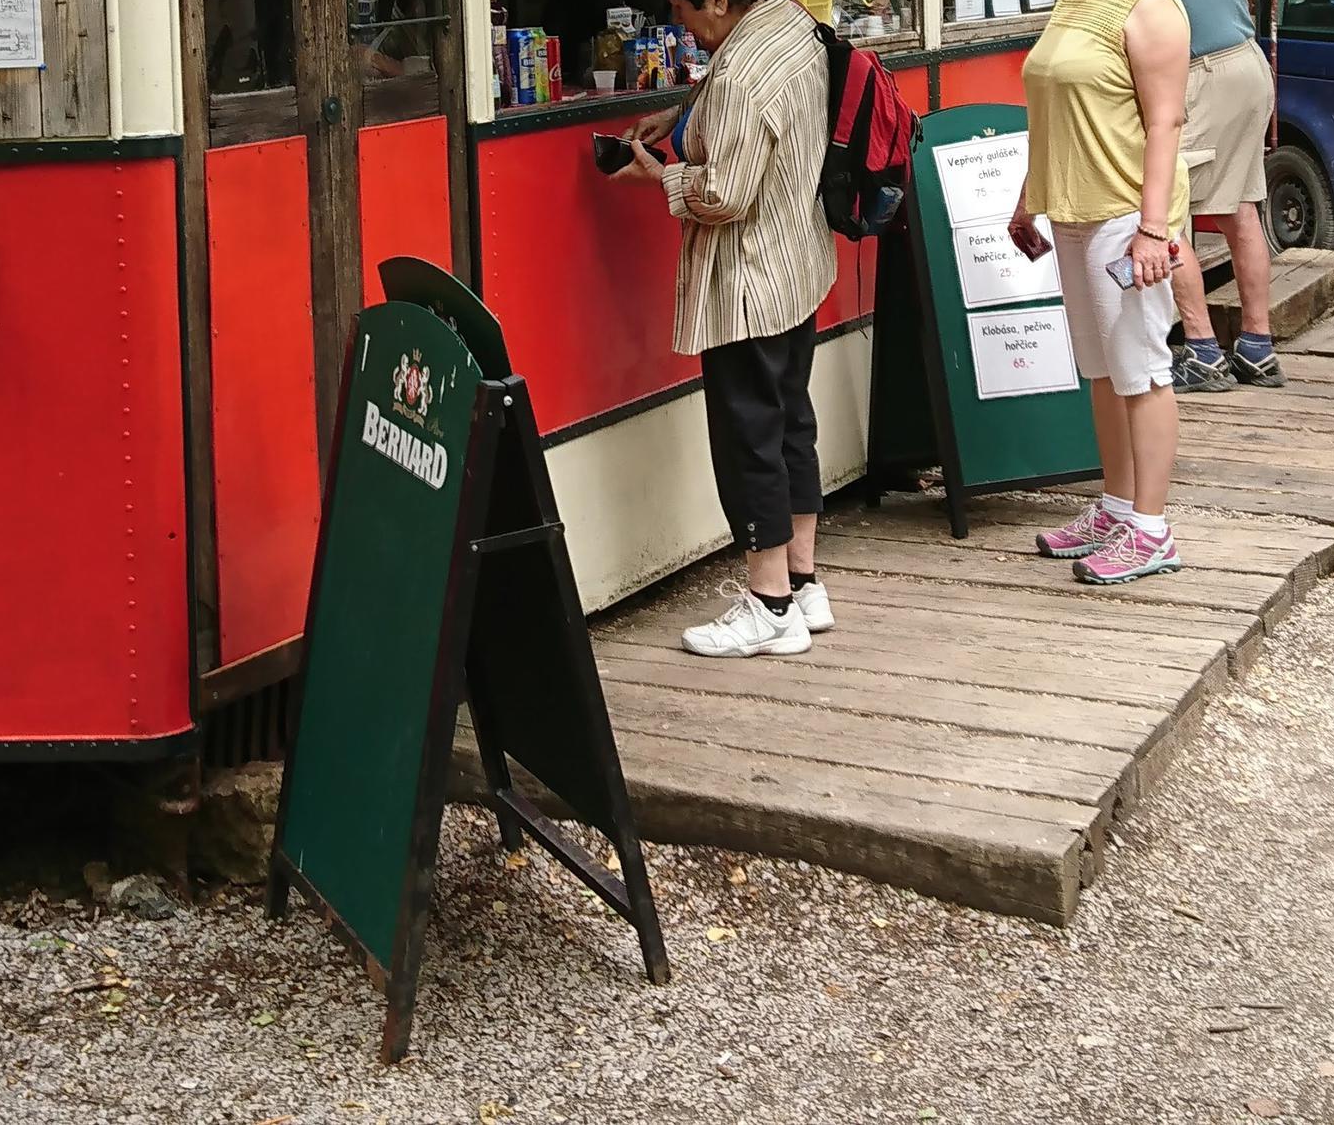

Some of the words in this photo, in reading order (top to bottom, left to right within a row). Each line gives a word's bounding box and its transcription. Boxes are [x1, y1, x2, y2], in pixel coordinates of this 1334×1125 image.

[947, 153, 983, 167] Vepřový
[978, 168, 1001, 179] chléb
[969, 234, 996, 245] Párek
[982, 323, 1020, 336] Klobása,
[1024, 321, 1055, 335] pečivo,
[1004, 340, 1038, 351] hořčice
[362, 400, 447, 490] BERNARD
